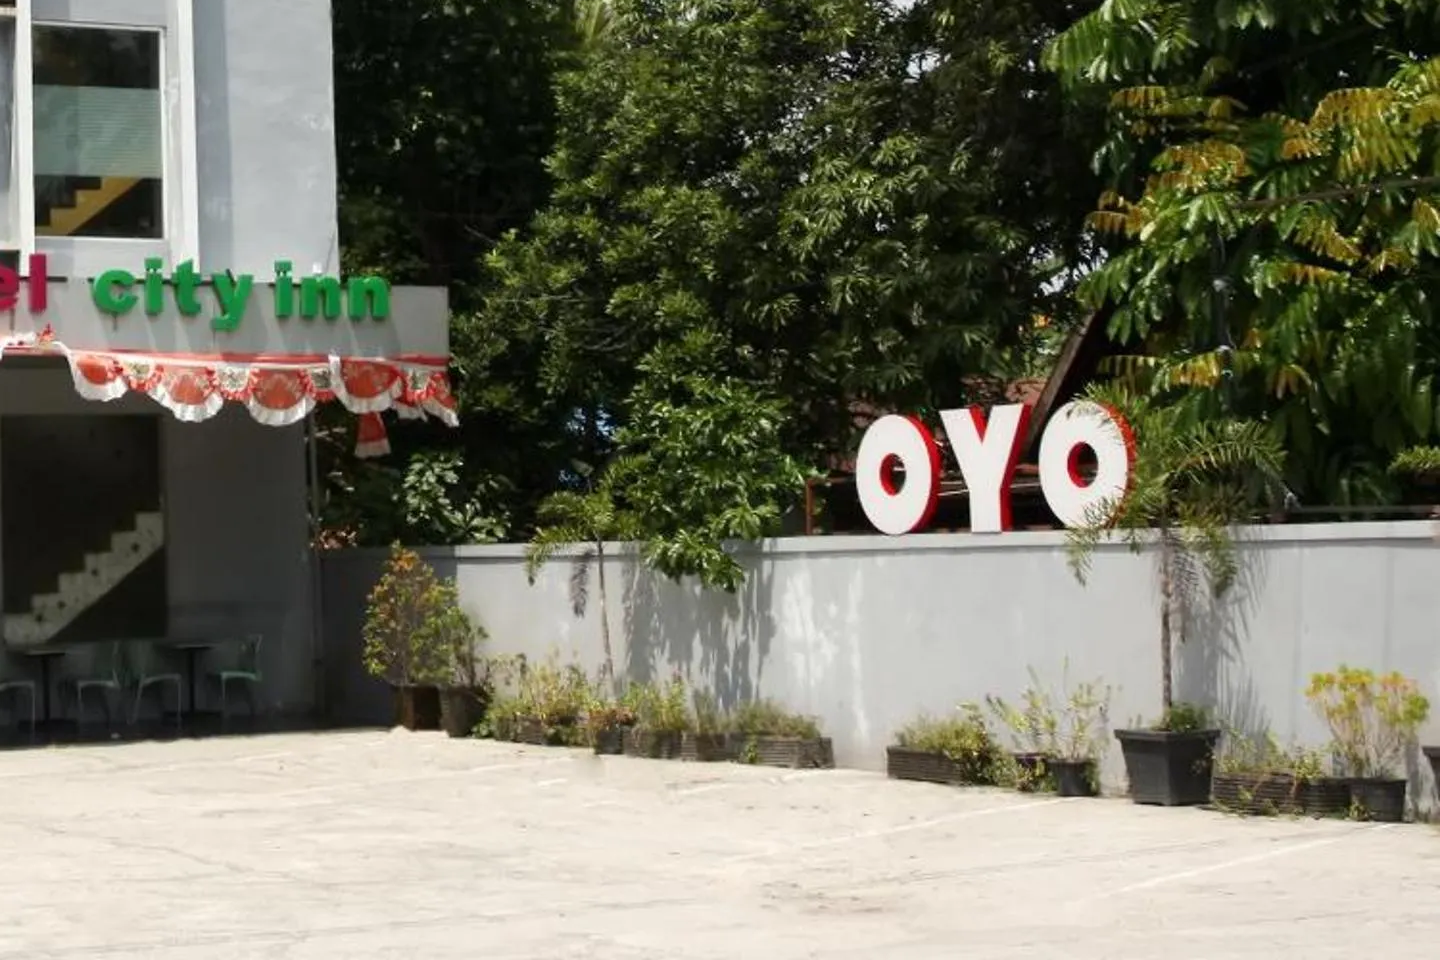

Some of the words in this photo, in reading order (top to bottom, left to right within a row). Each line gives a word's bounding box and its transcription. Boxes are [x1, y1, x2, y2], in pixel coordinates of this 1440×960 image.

[92, 257, 253, 331] city
[275, 260, 392, 320] inn
[856, 399, 1136, 535] OYO
